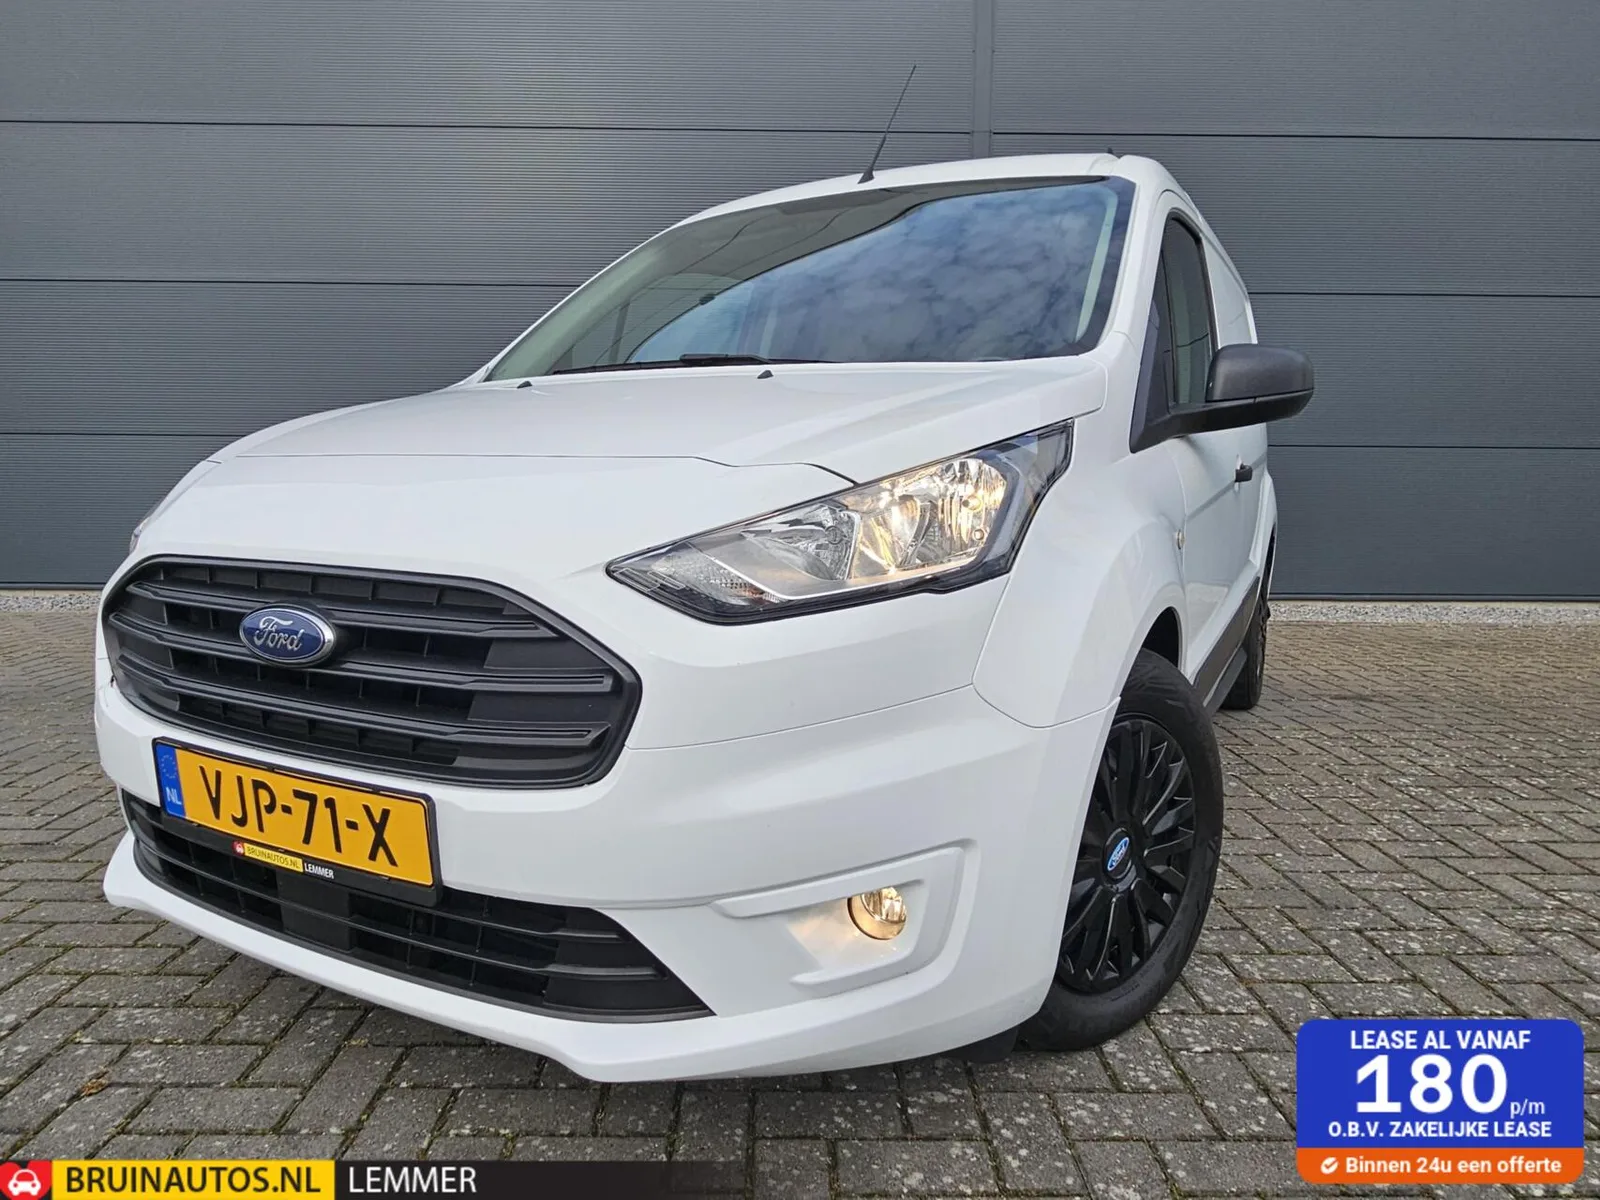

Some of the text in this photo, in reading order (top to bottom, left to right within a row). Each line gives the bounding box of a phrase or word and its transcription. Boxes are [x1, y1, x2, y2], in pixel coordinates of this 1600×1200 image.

[254, 616, 305, 651] Ford
[166, 786, 182, 805] NL
[199, 765, 398, 867] VJP-71-X
[246, 846, 334, 880] BRUINAUTOS.NL LEMMER
